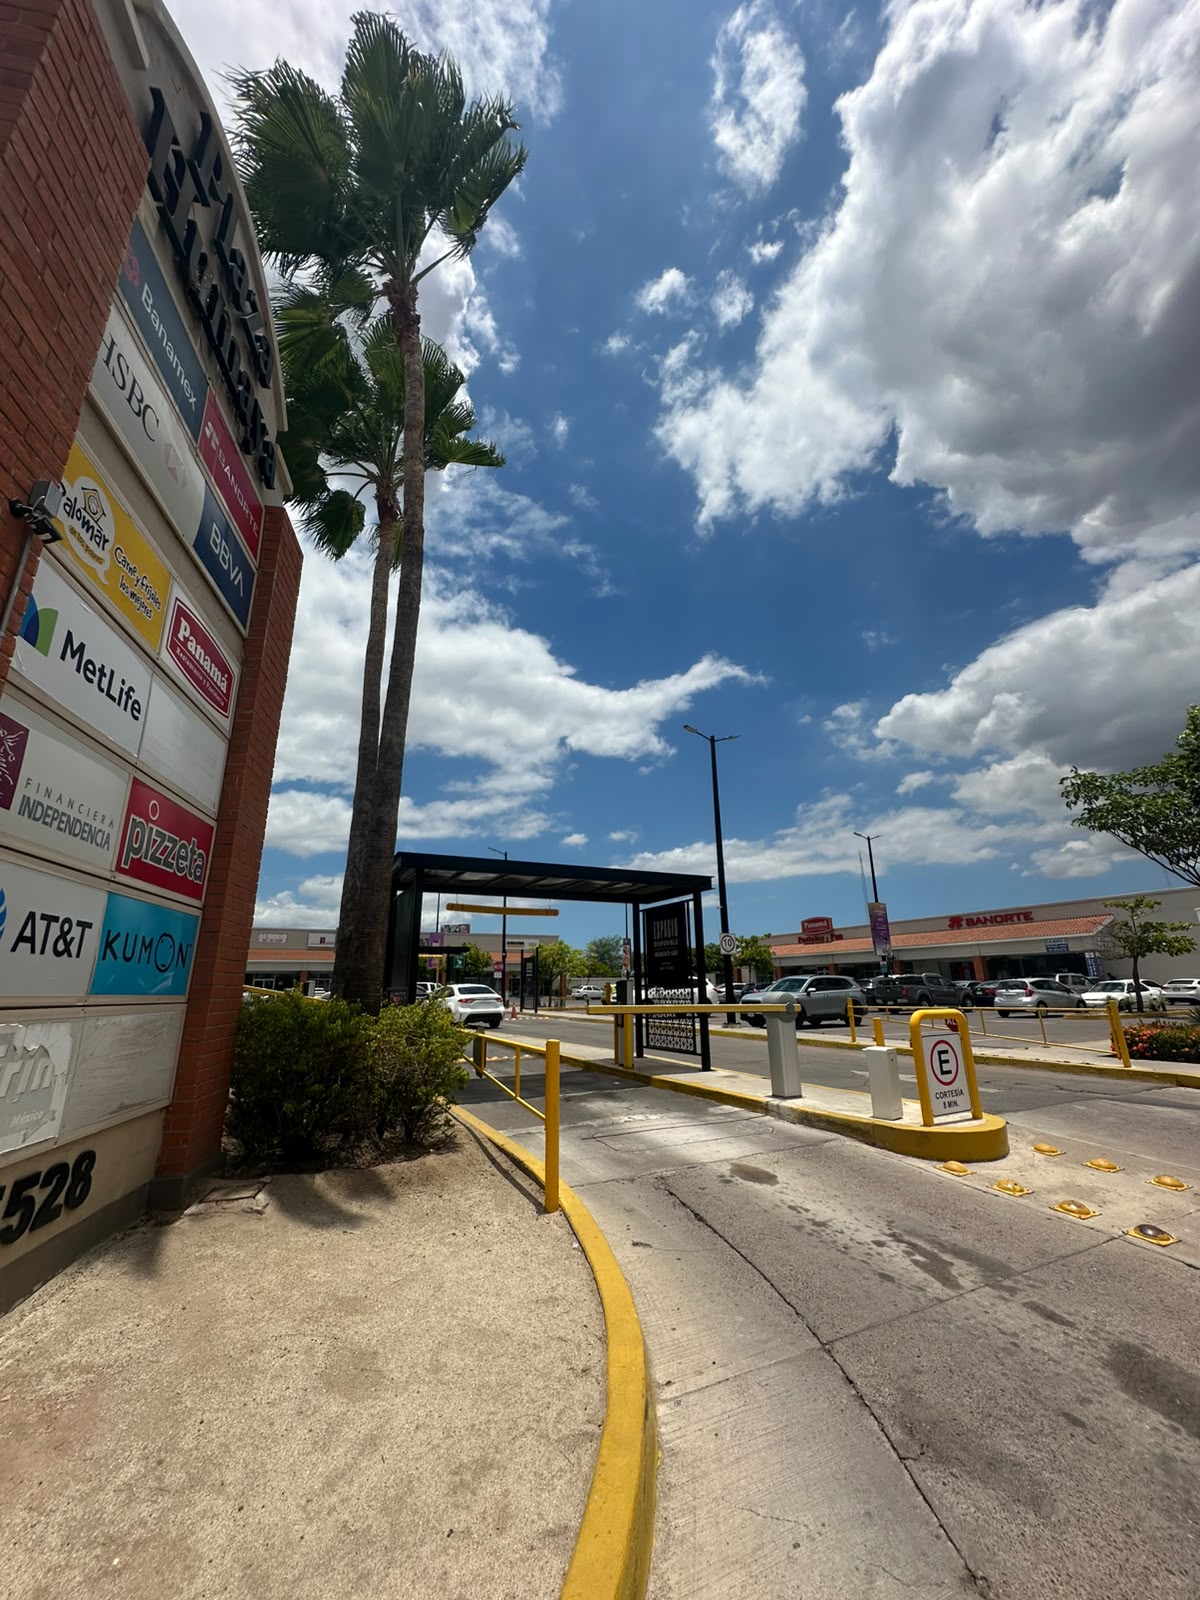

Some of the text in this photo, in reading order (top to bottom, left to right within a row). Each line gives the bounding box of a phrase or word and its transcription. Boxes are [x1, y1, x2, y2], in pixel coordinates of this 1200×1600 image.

[187, 112, 271, 389] Plaza
[141, 282, 199, 411] Banamex
[218, 449, 259, 538] BANORTE
[210, 522, 243, 597] BBVA
[120, 575, 153, 620] los mejores
[60, 629, 141, 721] MetLife
[178, 617, 228, 693] Panamá
[18, 794, 111, 851] INDEPENDENCIA
[25, 778, 114, 829] FINANCIERA
[121, 800, 206, 884] pizzeta
[10, 911, 93, 958] AT&T
[723, 937, 733, 949] 10
[966, 911, 1034, 927] BANORTE
[102, 929, 189, 972] KUMON
[938, 1050, 952, 1076] E
[935, 1088, 964, 1100] CORTESÍA
[0, 1150, 96, 1244] 528
